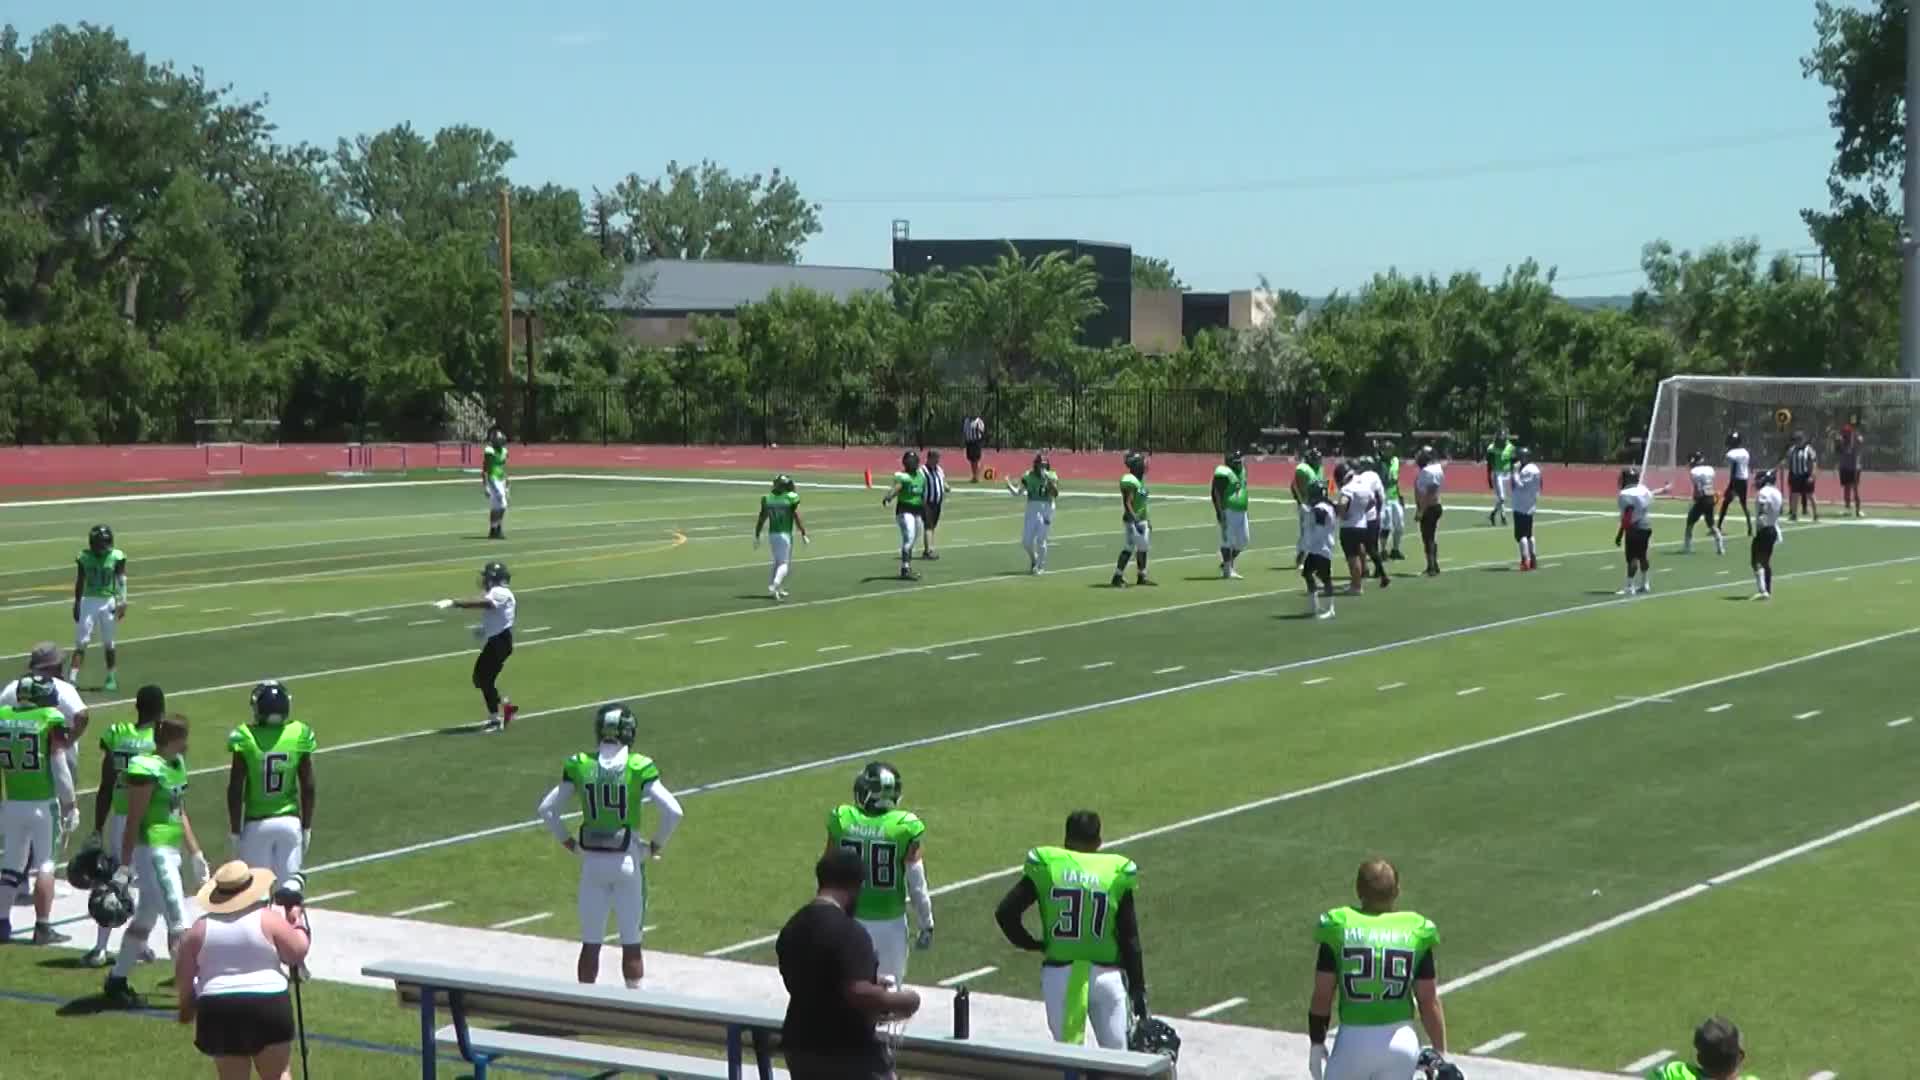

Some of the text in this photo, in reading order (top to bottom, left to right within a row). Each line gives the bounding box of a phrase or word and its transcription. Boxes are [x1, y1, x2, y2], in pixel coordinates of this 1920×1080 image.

[265, 752, 288, 794] 6
[584, 783, 628, 821] 14
[1051, 888, 1108, 940] 31
[1342, 945, 1415, 1001] 29
